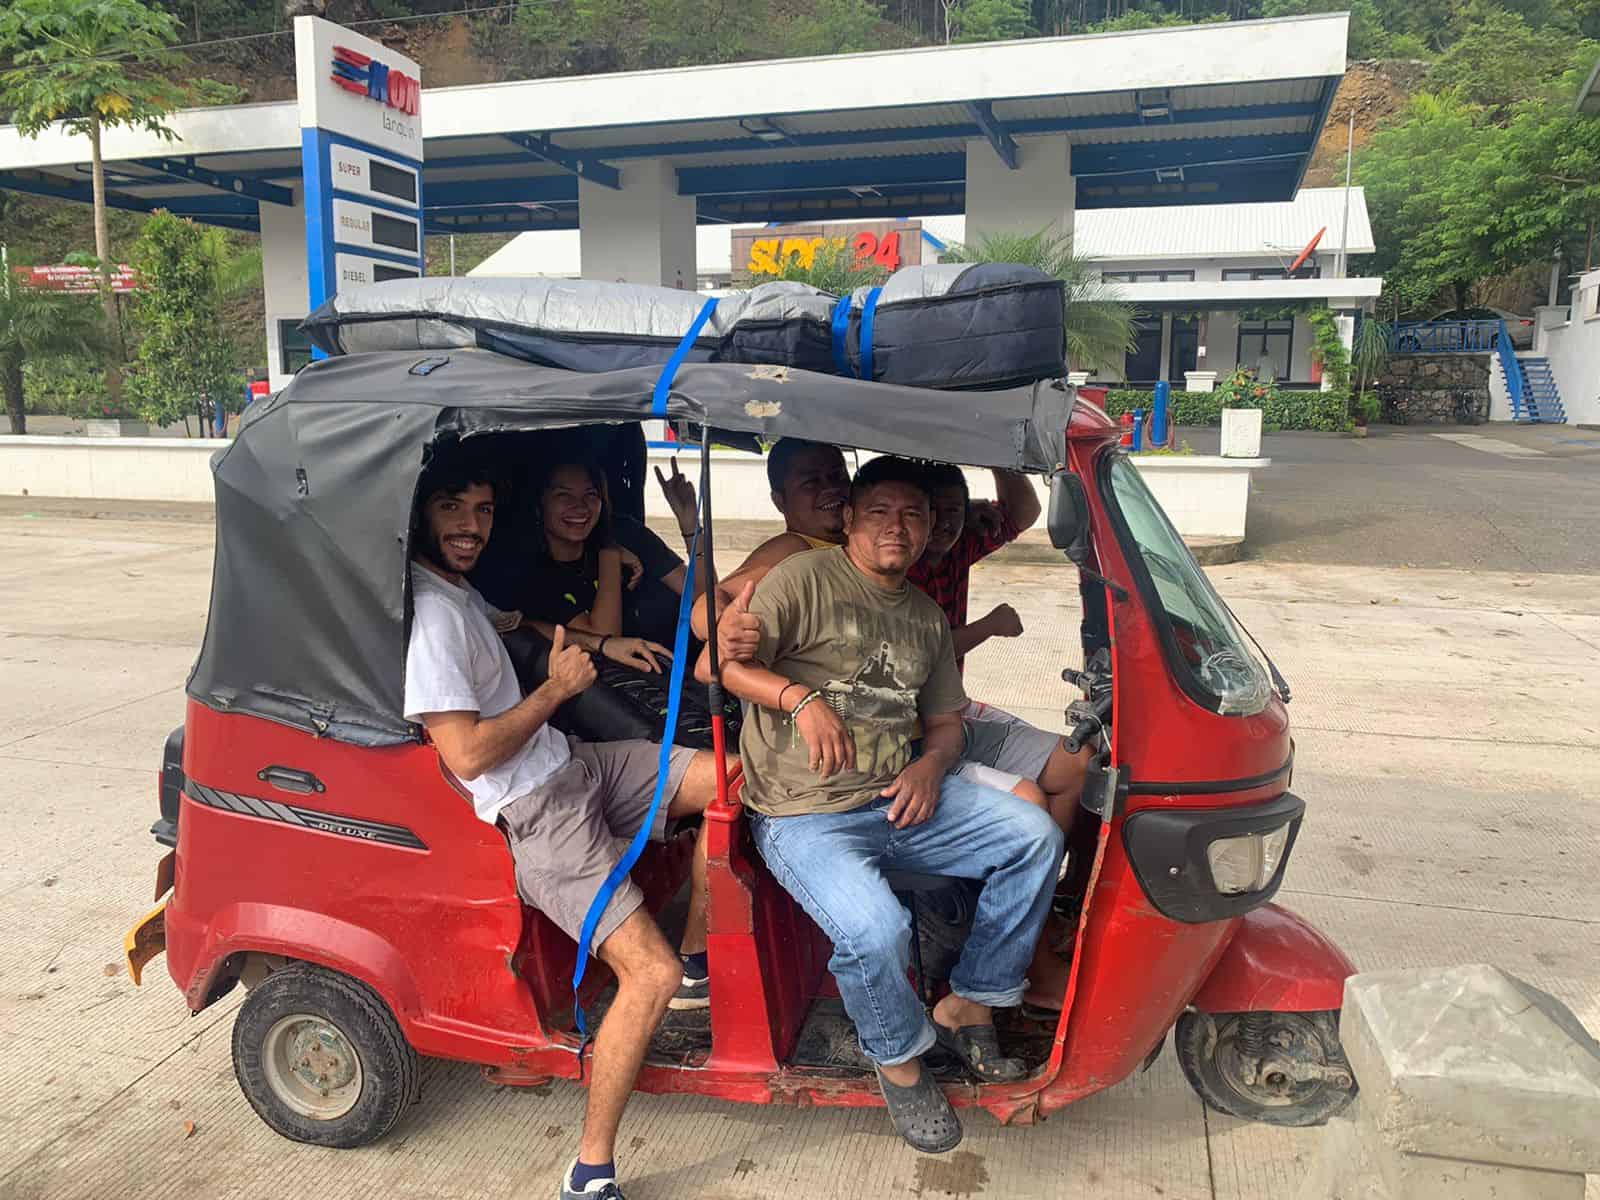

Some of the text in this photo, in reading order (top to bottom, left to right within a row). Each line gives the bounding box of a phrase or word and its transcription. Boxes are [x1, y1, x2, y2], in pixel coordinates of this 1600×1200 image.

[338, 161, 361, 177] SUPER
[343, 269, 367, 283] DIESEL
[318, 821, 378, 840] DELUXE
